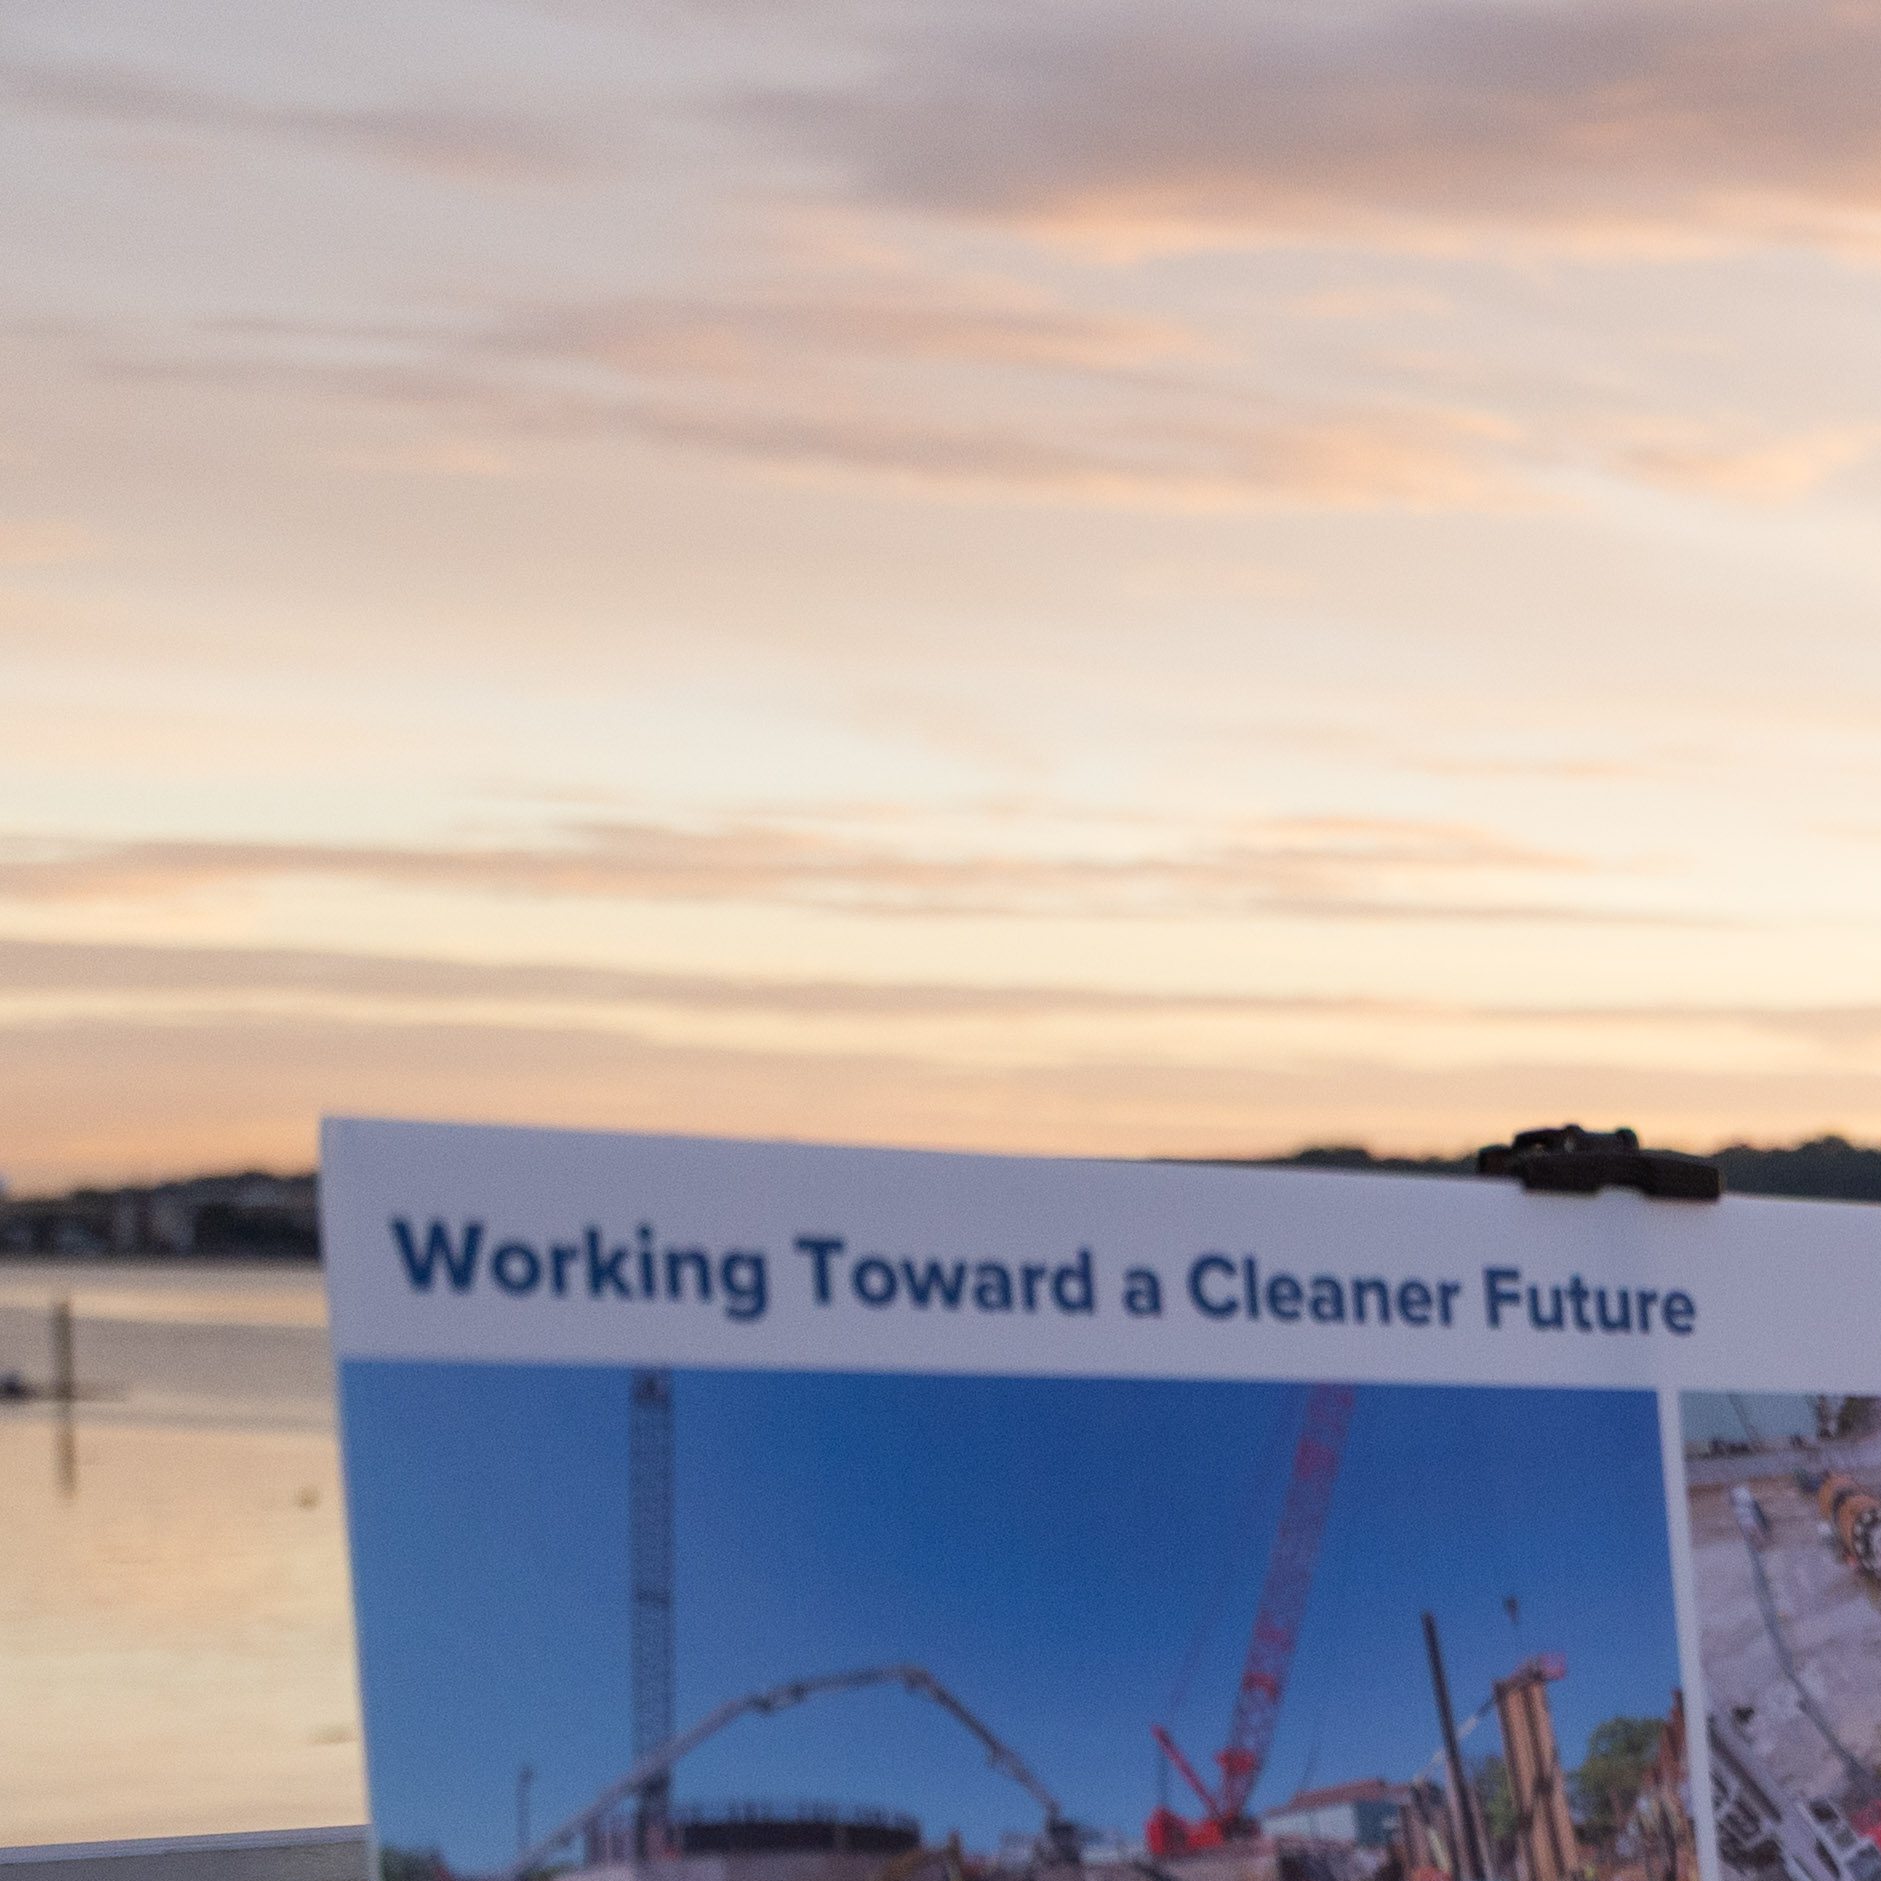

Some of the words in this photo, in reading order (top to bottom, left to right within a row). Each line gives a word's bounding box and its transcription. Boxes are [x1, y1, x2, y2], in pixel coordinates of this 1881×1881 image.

[390, 1222, 772, 1322] Working
[789, 1239, 1098, 1315] Toward
[1116, 1269, 1168, 1317] a
[1185, 1256, 1465, 1327] Cleaner
[1482, 1269, 1696, 1335] Future
